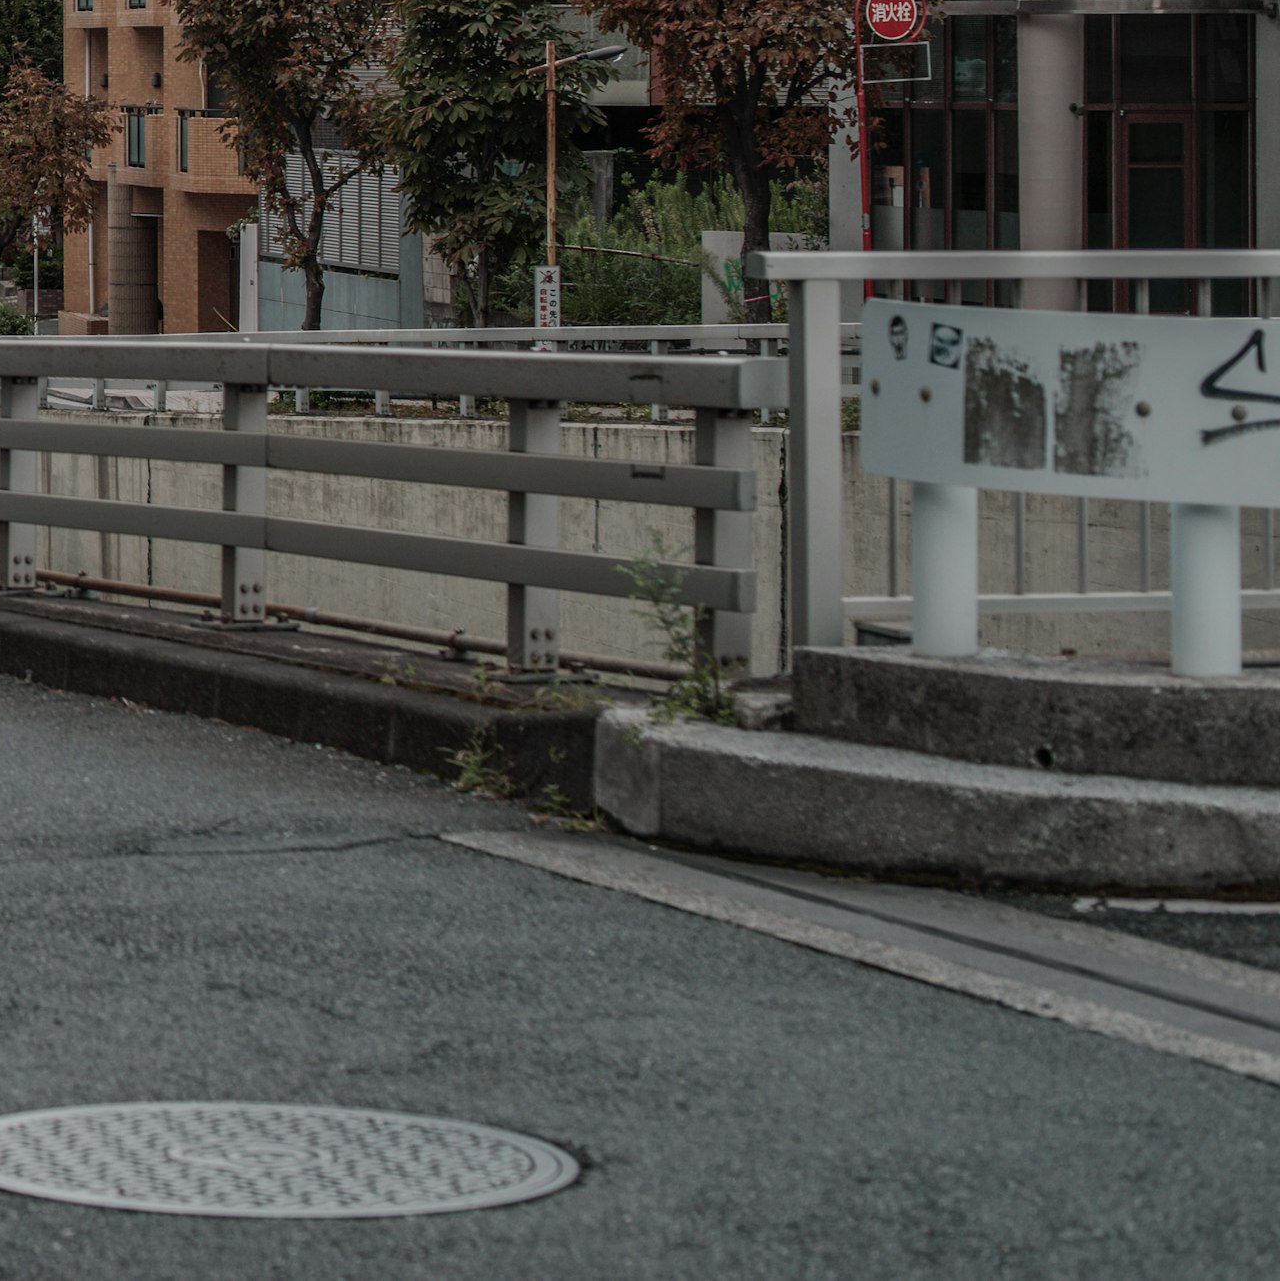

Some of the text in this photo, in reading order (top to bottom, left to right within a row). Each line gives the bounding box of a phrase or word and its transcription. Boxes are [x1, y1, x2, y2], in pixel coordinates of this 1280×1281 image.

[871, 1, 912, 22] 消火栓
[549, 288, 558, 319] この先
